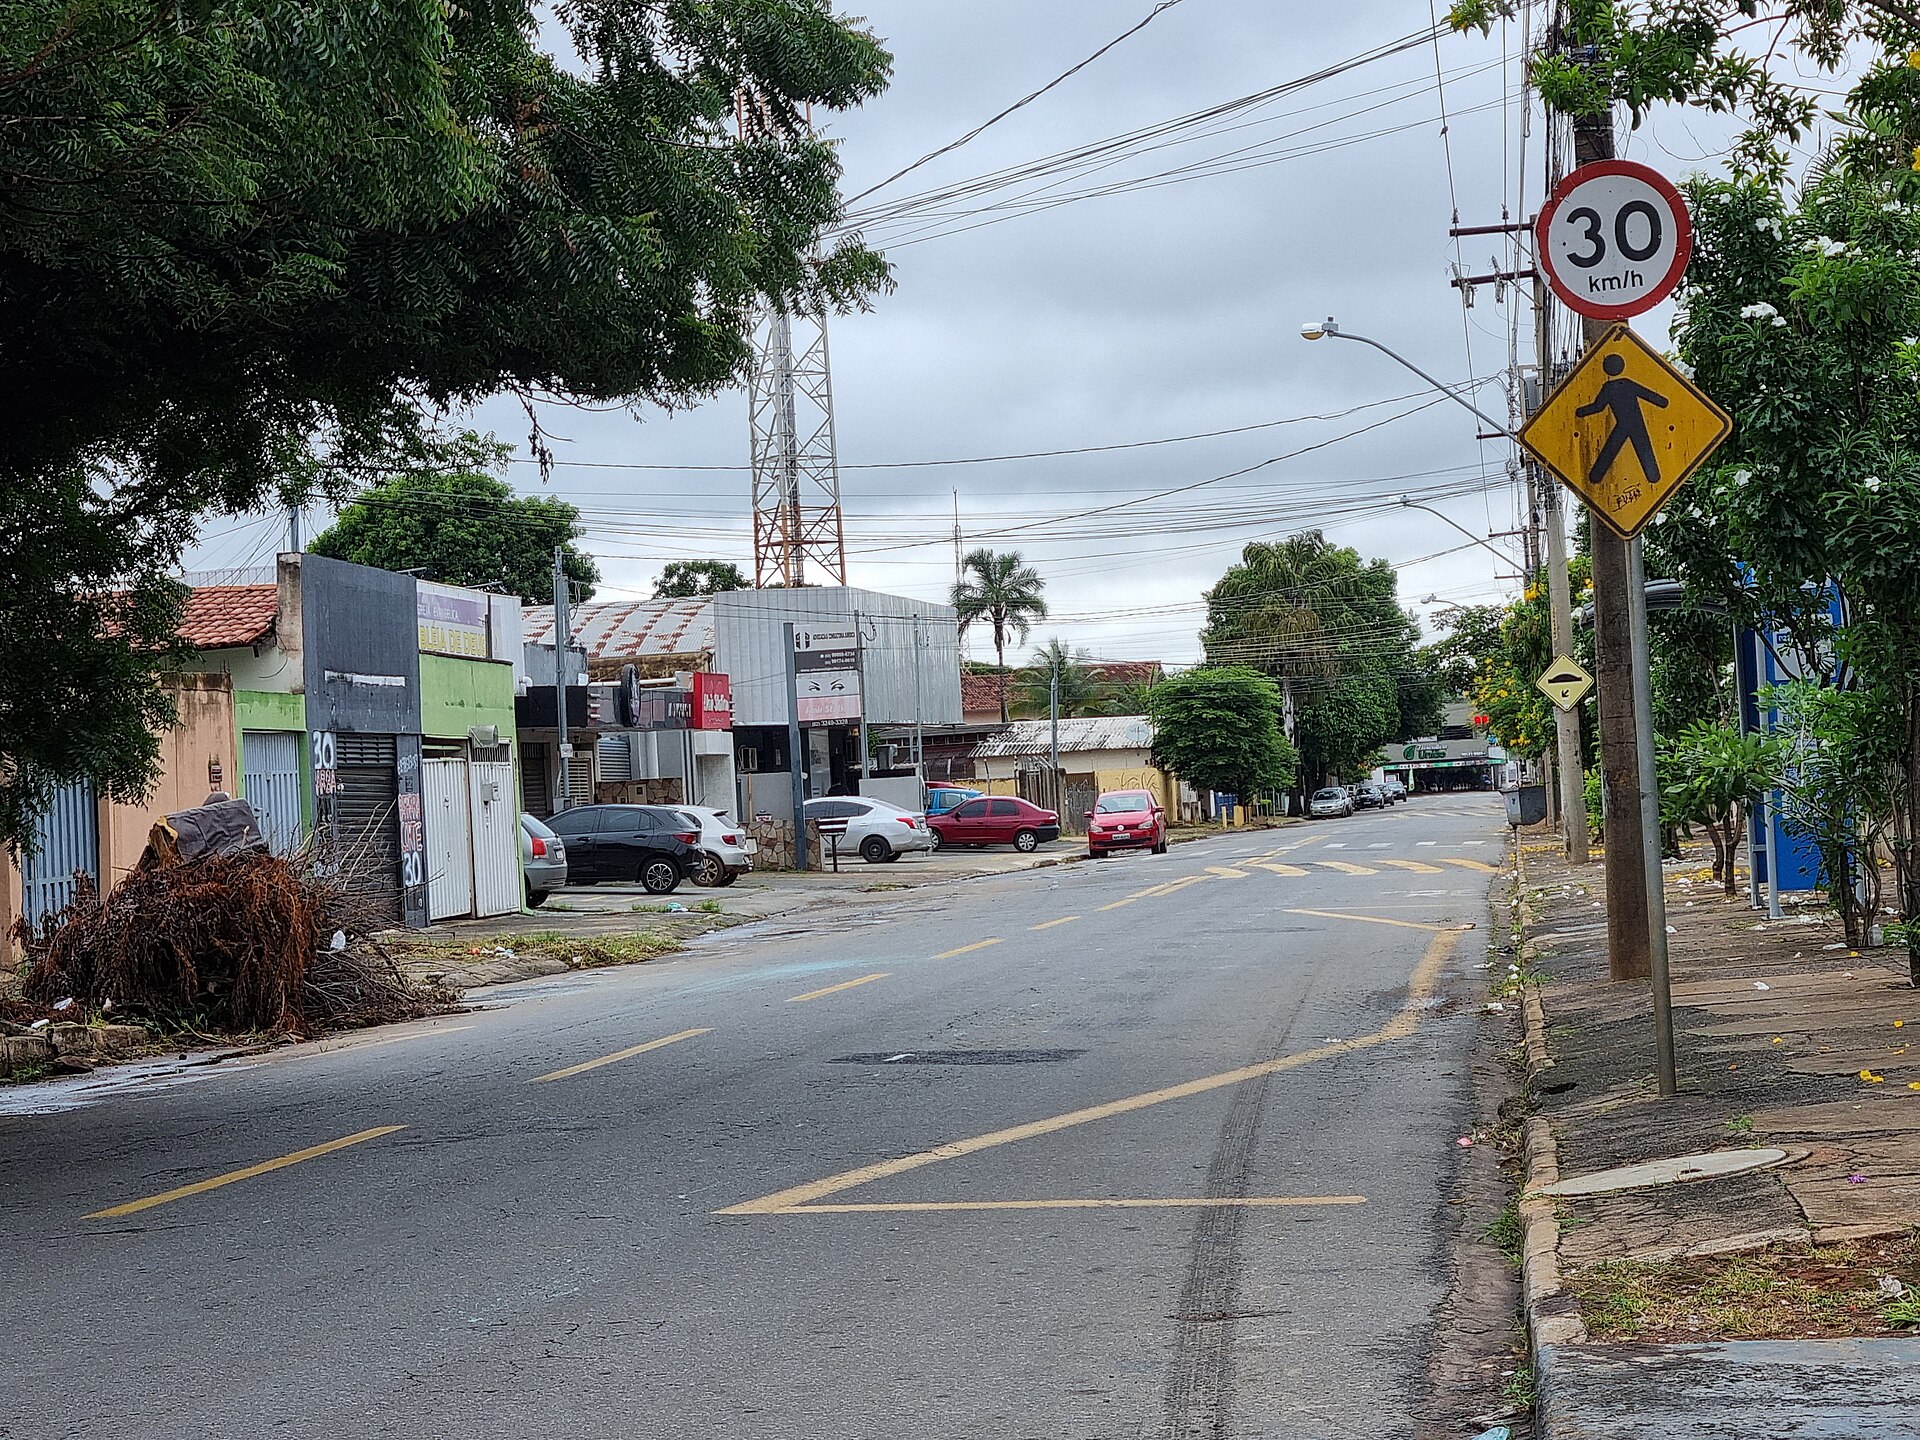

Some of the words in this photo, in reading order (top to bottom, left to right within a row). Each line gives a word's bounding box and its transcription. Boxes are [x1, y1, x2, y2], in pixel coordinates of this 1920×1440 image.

[1566, 200, 1663, 269] 30
[1588, 270, 1644, 293] km/h
[449, 629, 461, 654] DE
[463, 632, 486, 657] DEUS
[313, 731, 334, 769] 30
[404, 851, 421, 886] 30
